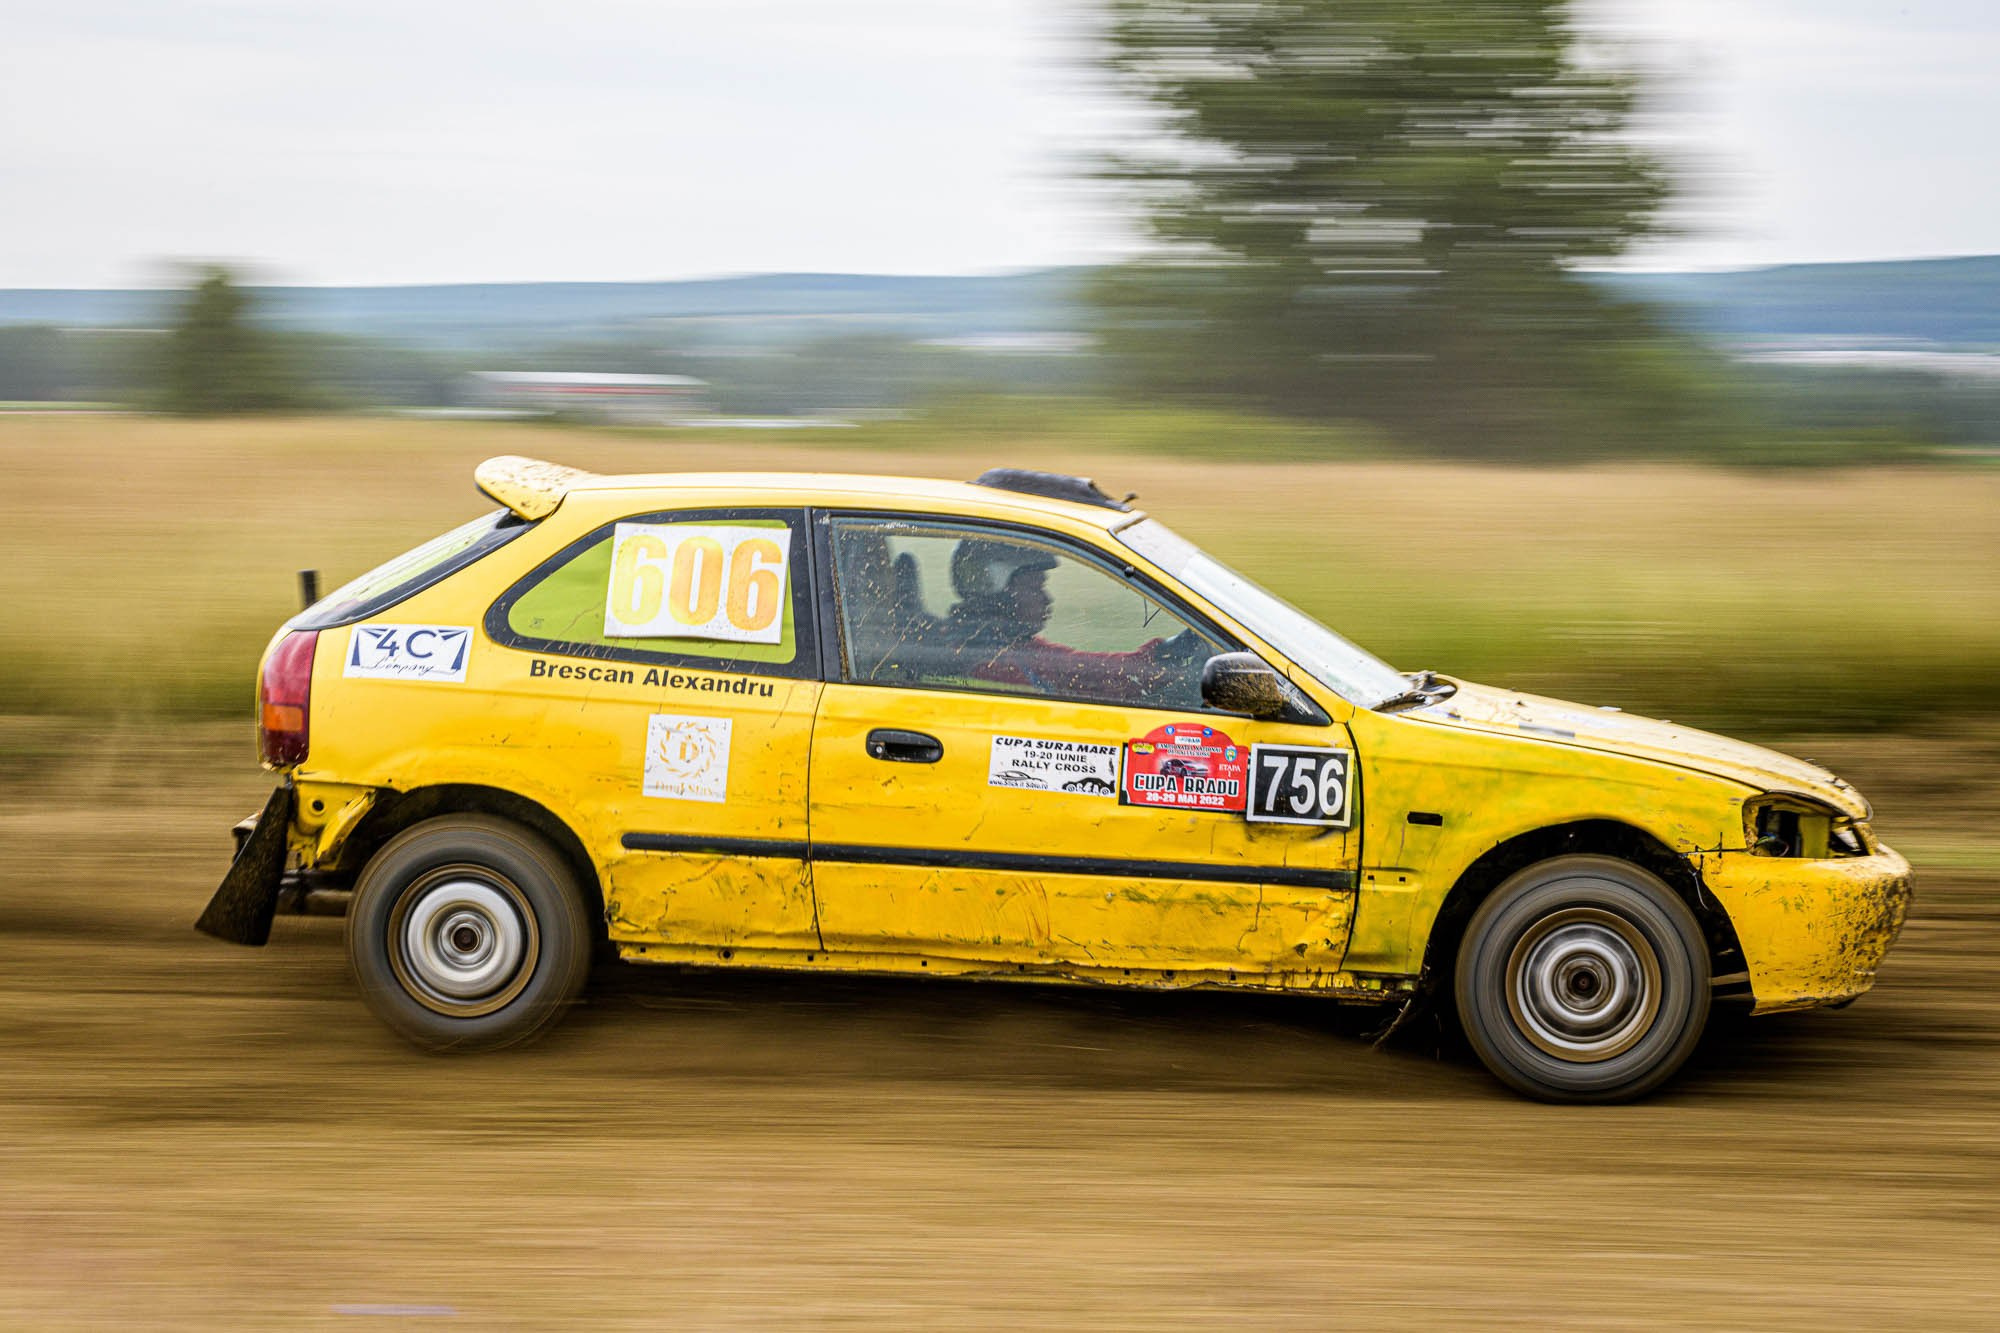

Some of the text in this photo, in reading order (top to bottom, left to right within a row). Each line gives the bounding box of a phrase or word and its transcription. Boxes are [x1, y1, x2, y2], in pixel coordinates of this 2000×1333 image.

[611, 535, 782, 631] 606
[529, 659, 774, 697] Brescan Alexandru
[995, 737, 1117, 756] CUPA SURA MARE
[1024, 750, 1087, 763] 19-20 IUNIE
[1012, 759, 1097, 774] RALLY CROSS
[1219, 763, 1241, 772] ETAPA
[1133, 773, 1240, 797] CUPA BRADU
[1263, 755, 1344, 816] 756
[1178, 794, 1197, 804] MAI
[1199, 795, 1225, 806] 2022
